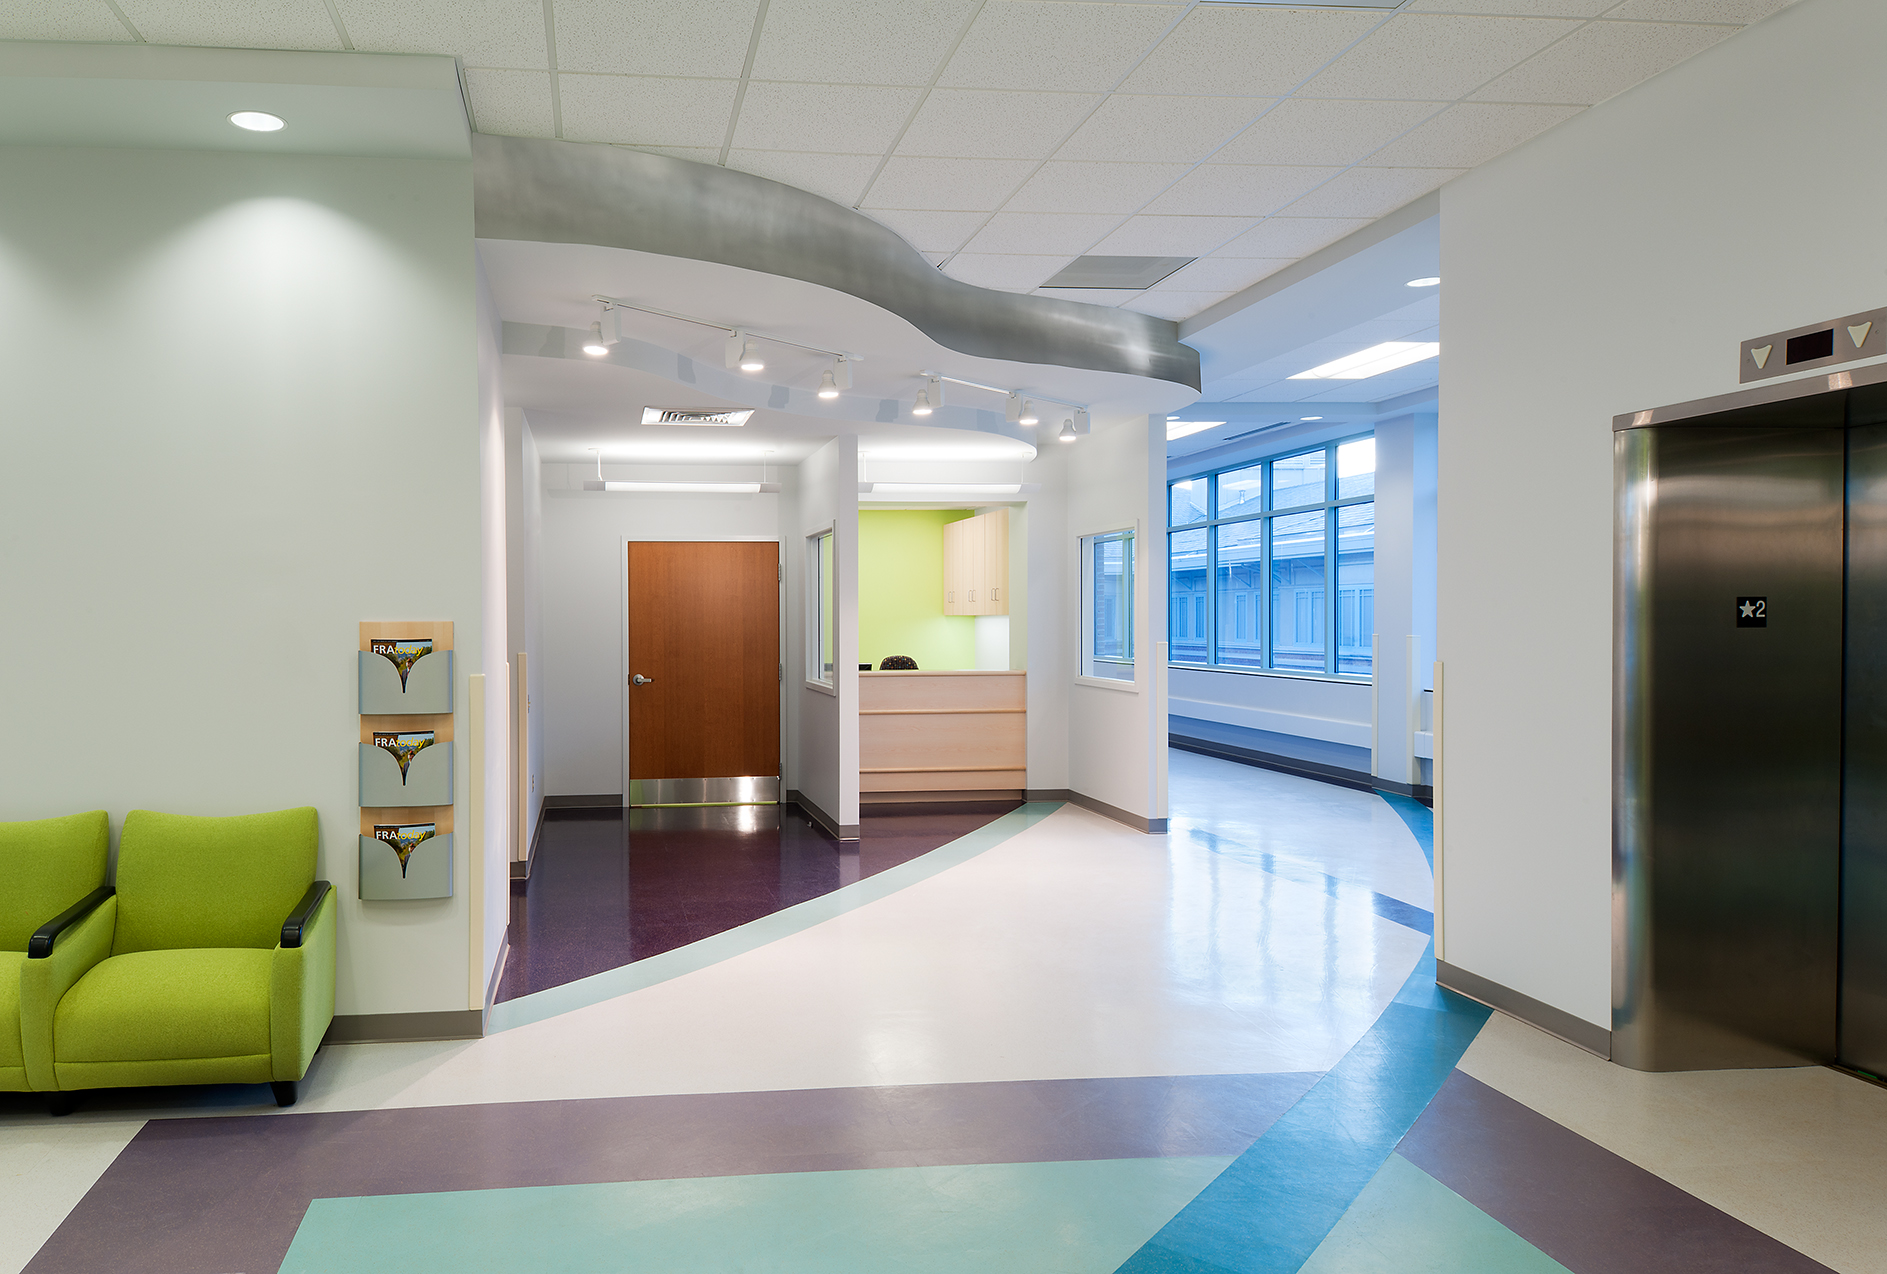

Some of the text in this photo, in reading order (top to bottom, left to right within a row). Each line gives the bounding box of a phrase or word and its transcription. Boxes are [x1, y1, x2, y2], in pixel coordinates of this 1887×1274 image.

[373, 645, 424, 657] FRAtoday
[375, 737, 426, 749] FRAtoday
[376, 829, 427, 841] FRAtoday
